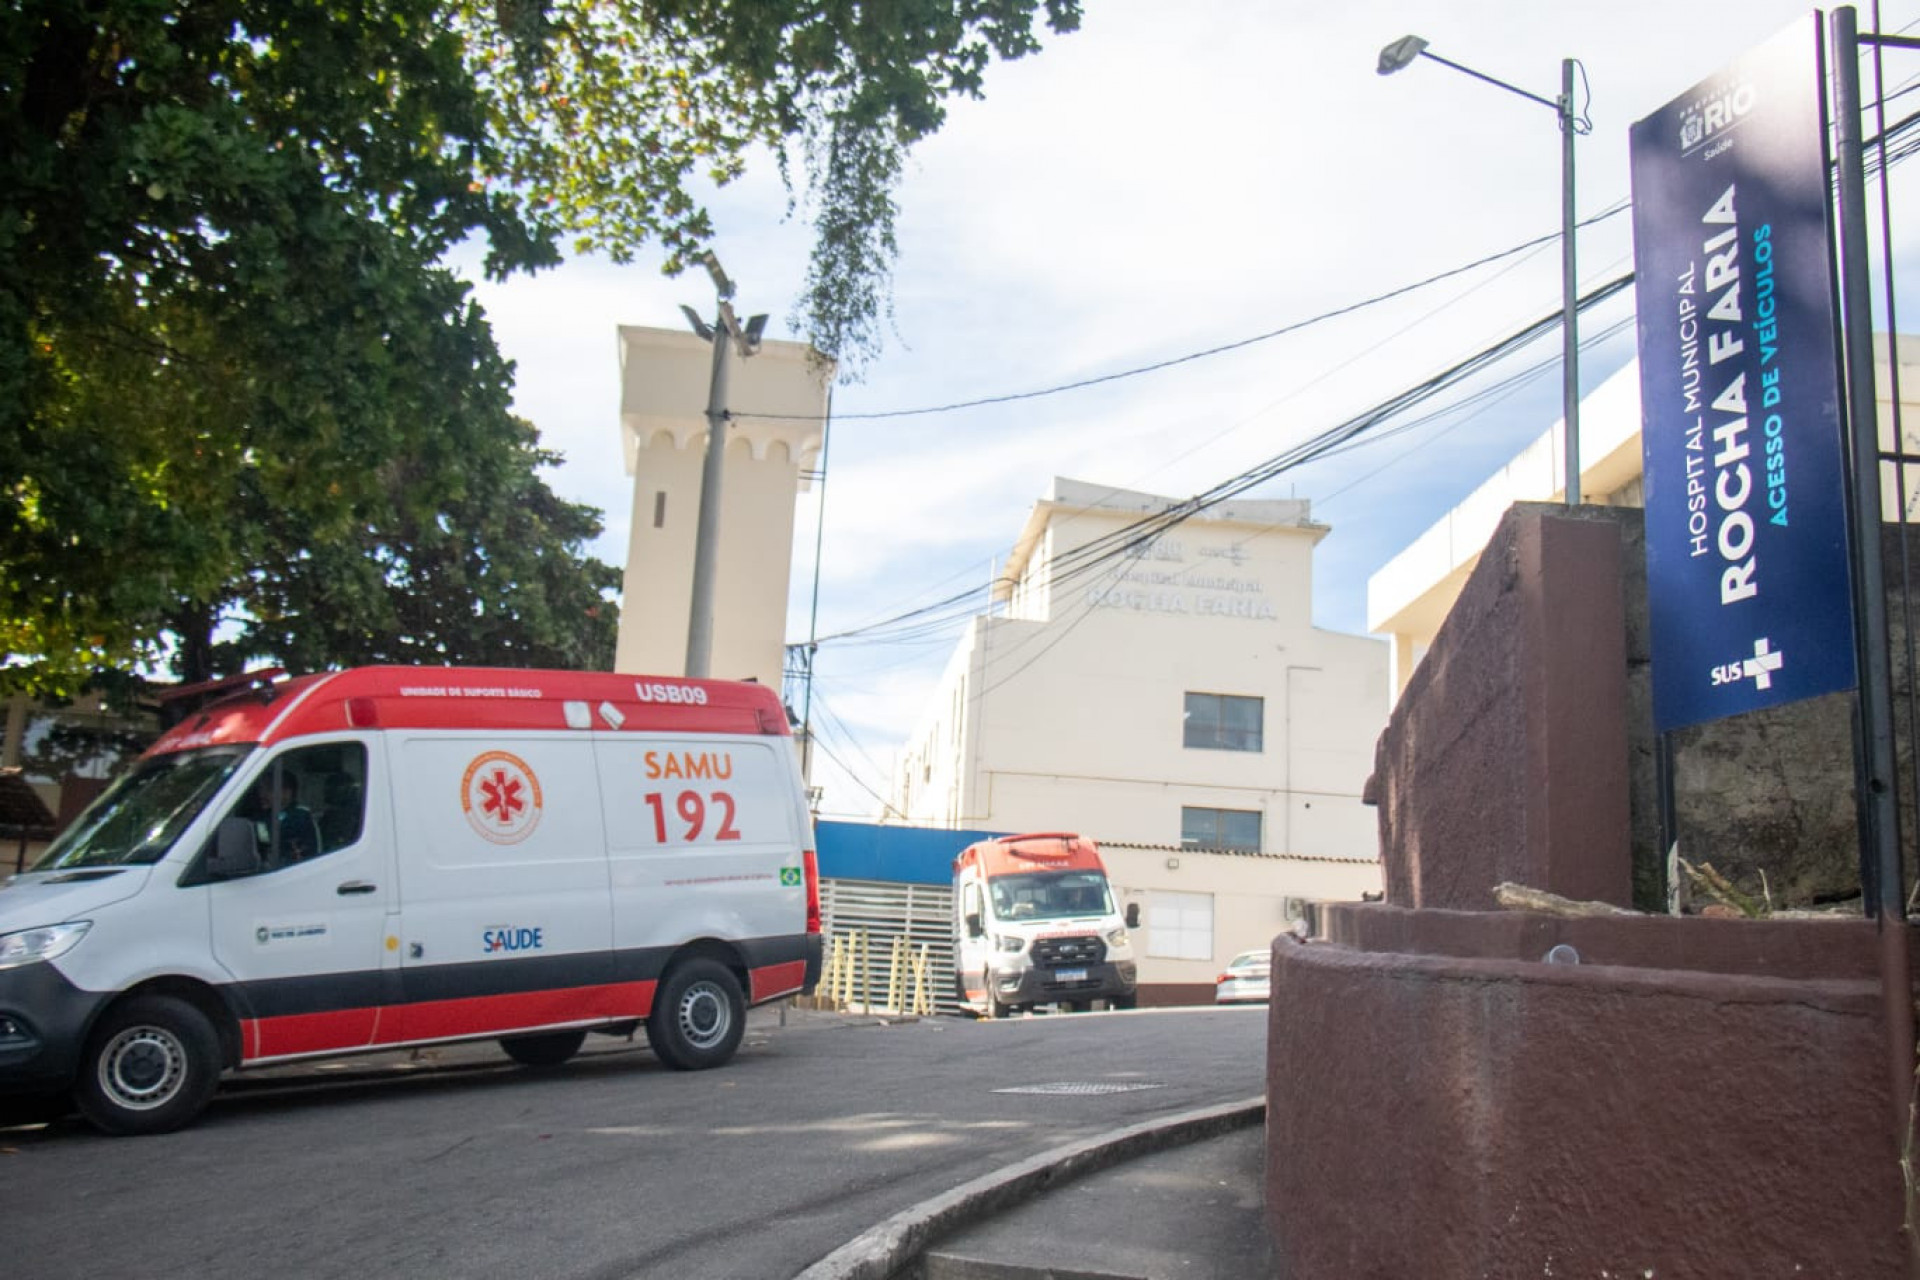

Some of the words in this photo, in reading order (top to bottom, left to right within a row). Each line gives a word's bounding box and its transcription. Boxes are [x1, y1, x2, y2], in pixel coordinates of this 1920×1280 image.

[1704, 84, 1754, 135] RIO
[1702, 183, 1744, 366] FARIA
[1753, 223, 1779, 365] VEÍCULOS
[1678, 260, 1702, 413] MUNICIPAL
[1762, 367, 1782, 408] DE
[1684, 416, 1708, 557] HOSPITAL
[1711, 371, 1757, 605] ROCHA
[1764, 414, 1788, 527] ACESSO
[635, 682, 708, 706] USB09
[1710, 661, 1743, 686] SUS
[643, 751, 733, 780] SAMU
[644, 789, 742, 844] 192
